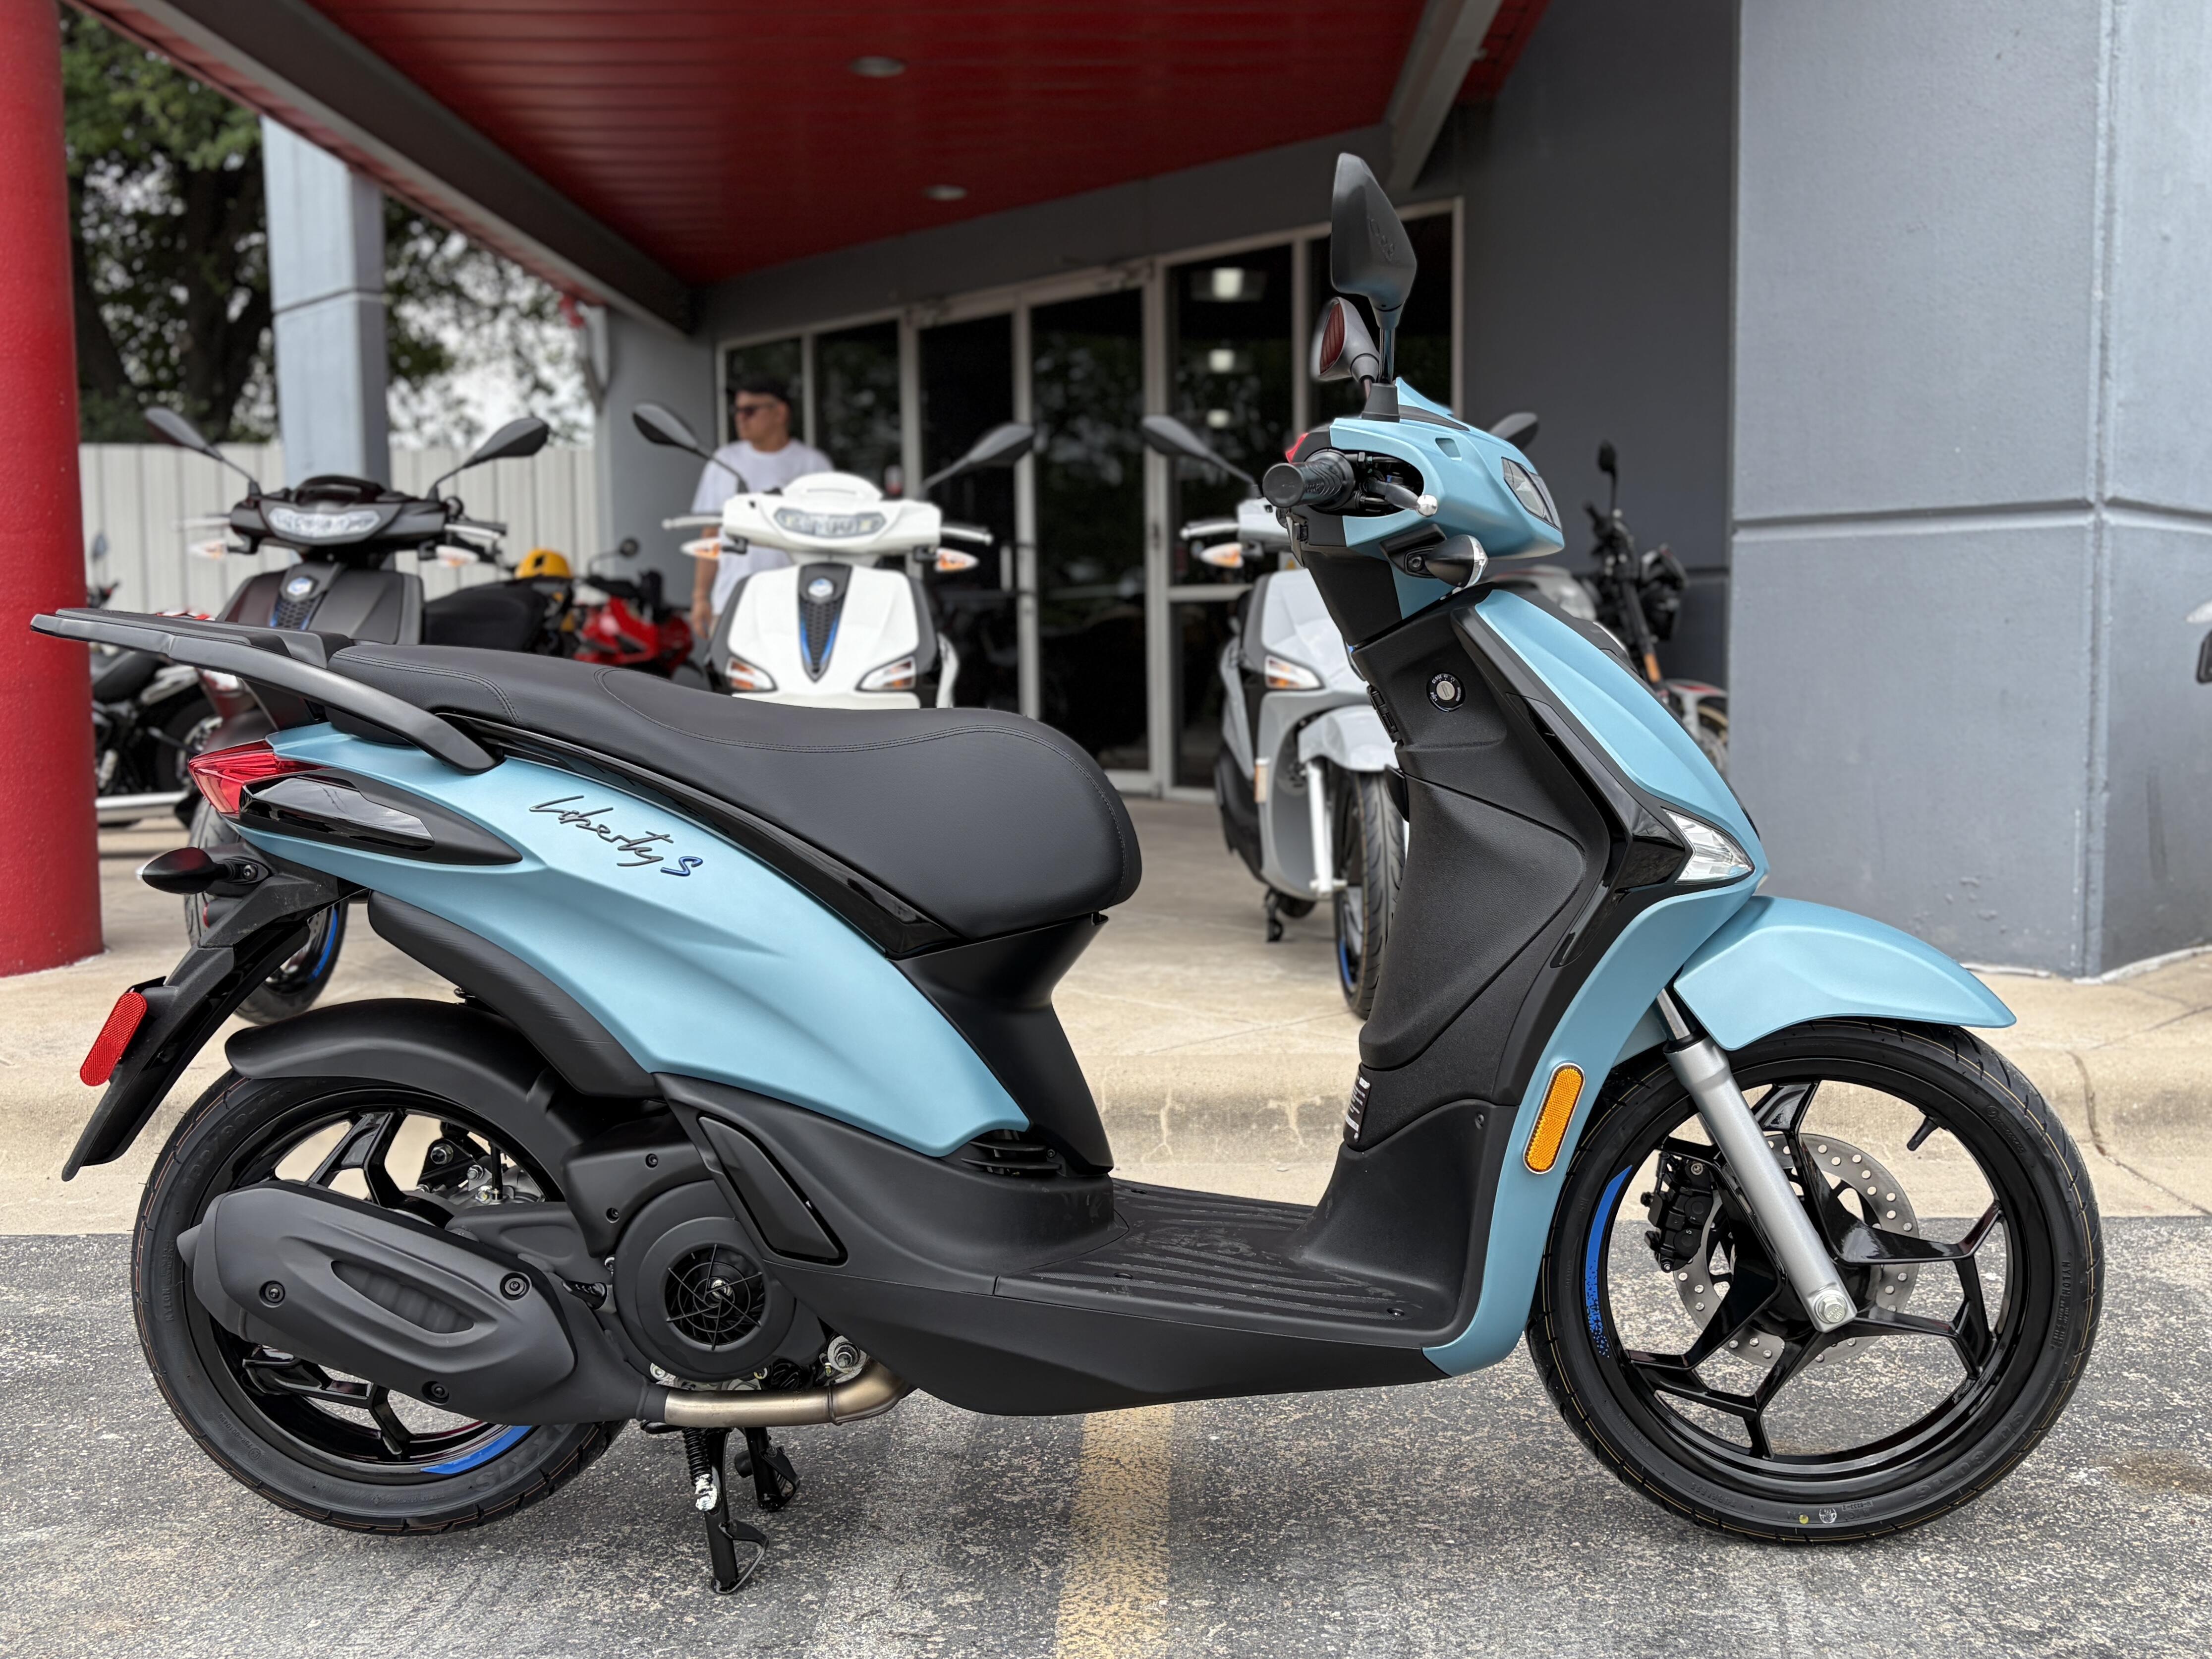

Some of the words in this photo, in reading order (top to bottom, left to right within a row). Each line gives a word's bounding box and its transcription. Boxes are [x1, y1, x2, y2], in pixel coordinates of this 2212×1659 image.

[529, 795, 674, 867] Liberty
[660, 856, 703, 876] S
[2062, 1260, 2071, 1297] NYLON
[163, 1288, 174, 1321] NYLON
[1690, 1483, 1736, 1506] TUBELESS
